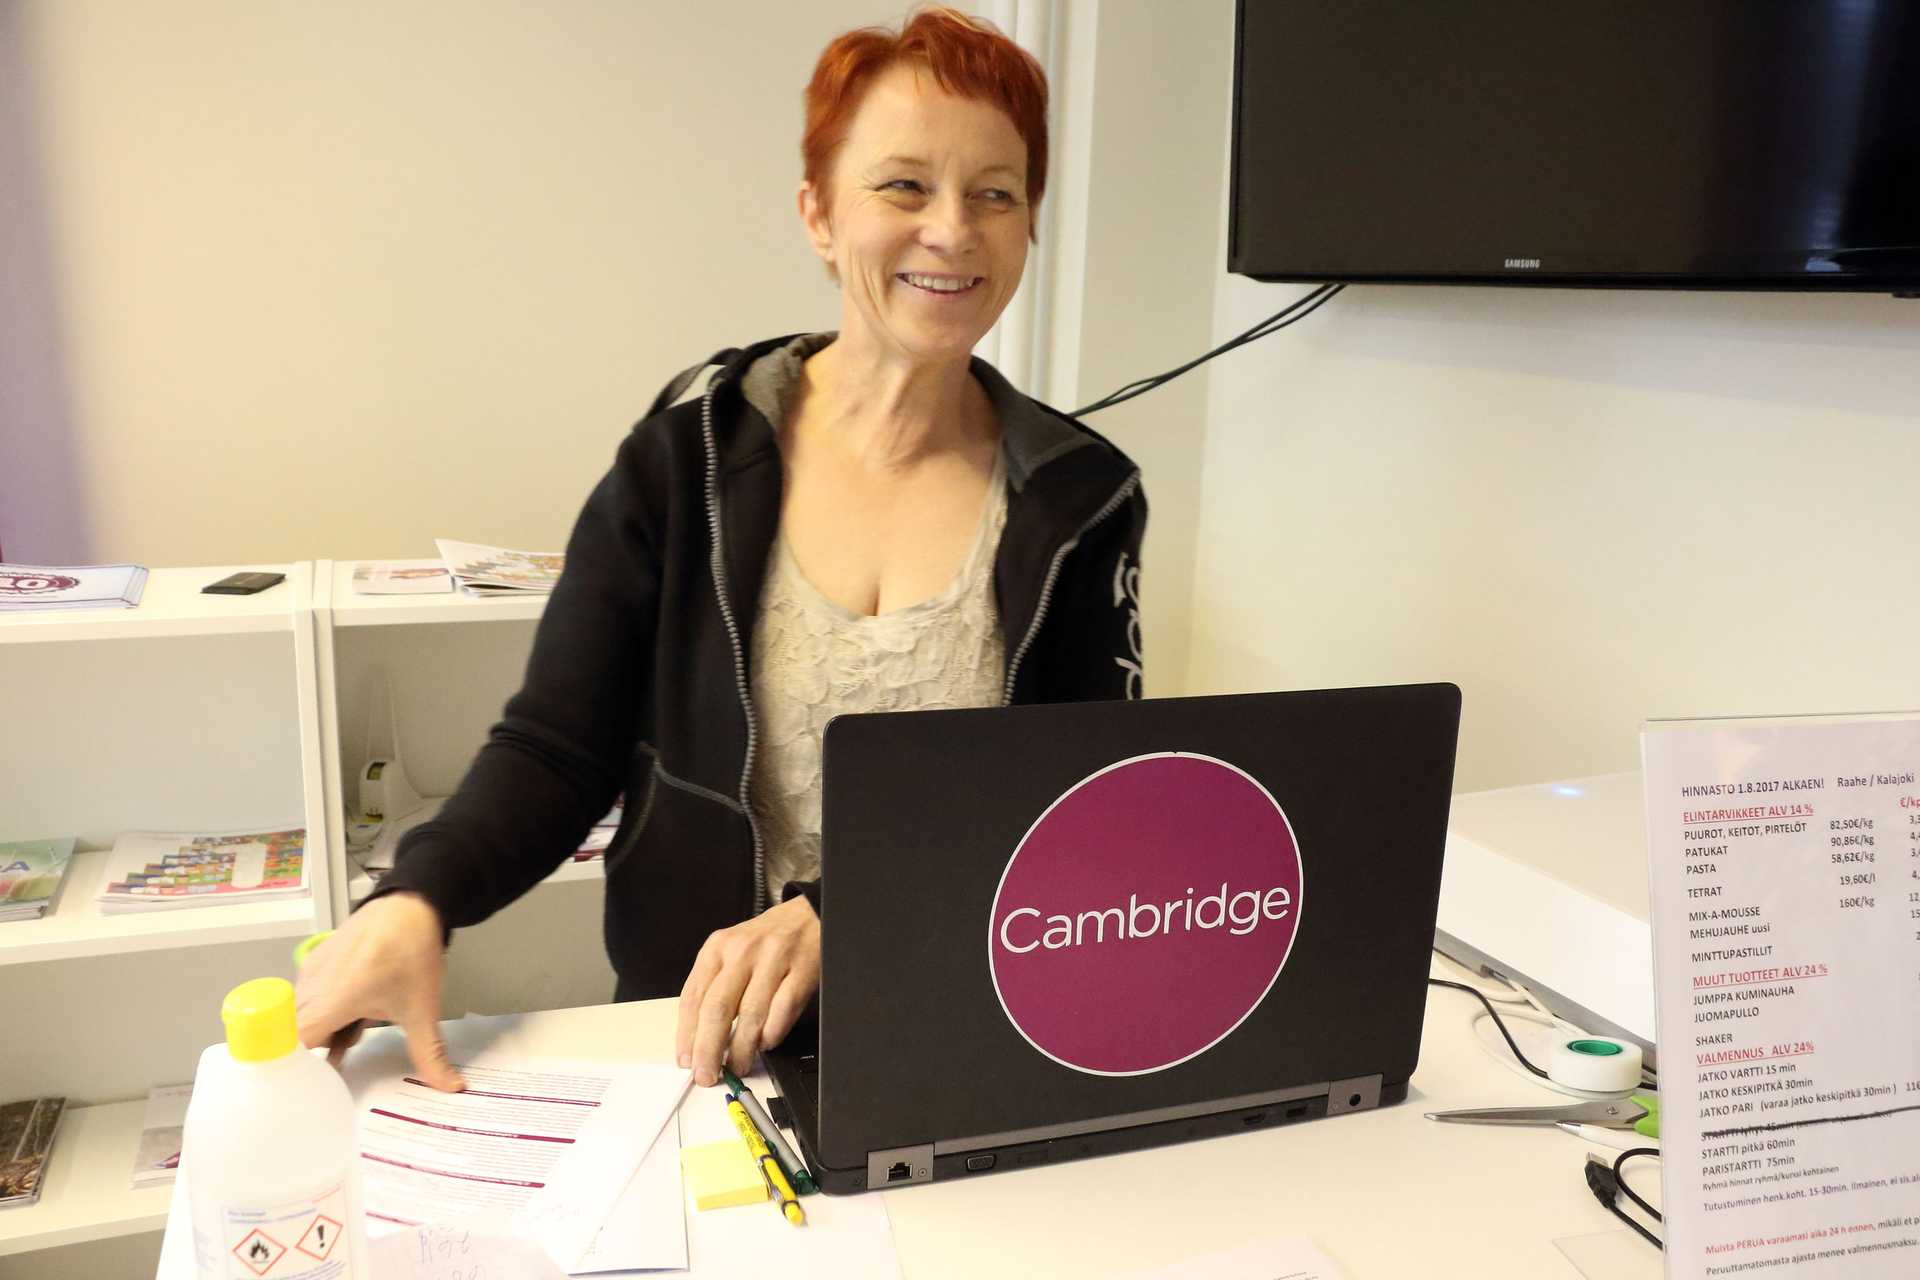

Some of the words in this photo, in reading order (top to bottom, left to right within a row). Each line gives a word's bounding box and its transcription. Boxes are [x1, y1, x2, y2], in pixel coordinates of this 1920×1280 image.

[1681, 784, 1735, 798] HINNASTO
[1738, 781, 1779, 794] 1.8.2017
[1782, 778, 1825, 791] ALKAEN!
[1837, 776, 1867, 788] Raahe
[1869, 775, 1875, 787] /
[1877, 773, 1915, 786] Kalajoki
[1683, 806, 1766, 823] ELINTARVIKKEET
[1768, 804, 1788, 818] ALV
[1790, 804, 1802, 816] 14
[1803, 803, 1814, 815] %
[1684, 828, 1726, 841] PUUROT,
[1728, 825, 1763, 838] KEITOT,
[1765, 821, 1807, 835] PIRTELÖT
[1830, 817, 1874, 831] 82,50€/kg
[1830, 834, 1875, 847] 90,86€/kg
[1685, 846, 1728, 858] PATUKAT
[1831, 851, 1875, 864] 58,62€/kg
[1686, 864, 1717, 875] PASTA
[1839, 872, 1876, 886] 19,60€/l
[1687, 886, 1722, 899] TETRAT
[1839, 895, 1875, 908] 160€/kg
[1000, 882, 1291, 953] Cambridge
[1689, 906, 1761, 921] MIX-A-MOUSSE
[1690, 925, 1749, 940] MEHUJAUHE
[1751, 923, 1770, 934] uusi
[1691, 945, 1773, 963] MINTTUPASTILLIT
[1693, 974, 1726, 987] MUUT
[1728, 968, 1779, 983] TUOTTEET
[1782, 966, 1802, 978] ALV
[1804, 965, 1816, 976] 24
[1818, 963, 1828, 975] %
[1693, 992, 1734, 1006] JUMPPA
[1735, 986, 1795, 1001] KUMINAUHA
[1694, 1007, 1760, 1023] JUOMAPULLO
[1695, 1033, 1733, 1046] SHAKER
[1697, 1048, 1764, 1065] VALMENNUS
[1772, 1043, 1791, 1055] ALV
[1792, 1040, 1815, 1053] 24%
[1697, 1071, 1728, 1084] JATKO
[1730, 1067, 1763, 1079] VARTTI
[1766, 1065, 1777, 1076] 15
[1779, 1063, 1796, 1073] min
[1699, 1087, 1729, 1101] JATKO
[1731, 1081, 1783, 1098] KESKIPITKÄ
[1785, 1078, 1813, 1091] 30min
[1700, 1105, 1730, 1118] JATKO
[1732, 1102, 1754, 1114] PARI
[1760, 1098, 1789, 1112] (varaa
[1791, 1096, 1814, 1109] jatko
[1815, 1090, 1861, 1105] keskipitkä
[1863, 1086, 1891, 1098] 30min
[1701, 1146, 1740, 1160] STARTTI
[1741, 1140, 1764, 1155] pitkä
[1766, 1137, 1796, 1150] 60min
[1702, 1160, 1761, 1176] PARISTARTTI
[1766, 1155, 1795, 1168] 75min
[1703, 1180, 1728, 1192] Ryhmä
[1729, 1177, 1753, 1188] hinnat
[1703, 1197, 1762, 1212] Tutustuminen
[1705, 1243, 1735, 1256] Muista
[1736, 1239, 1765, 1251] PERUA
[1766, 1231, 1809, 1246] varaamasi
[1810, 1229, 1828, 1240] aika
[1829, 1227, 1839, 1237] 24
[1840, 1225, 1847, 1235] h
[1903, 1216, 1913, 1226] et
[1791, 1252, 1816, 1266] ajasta
[1817, 1248, 1846, 1260] menee
